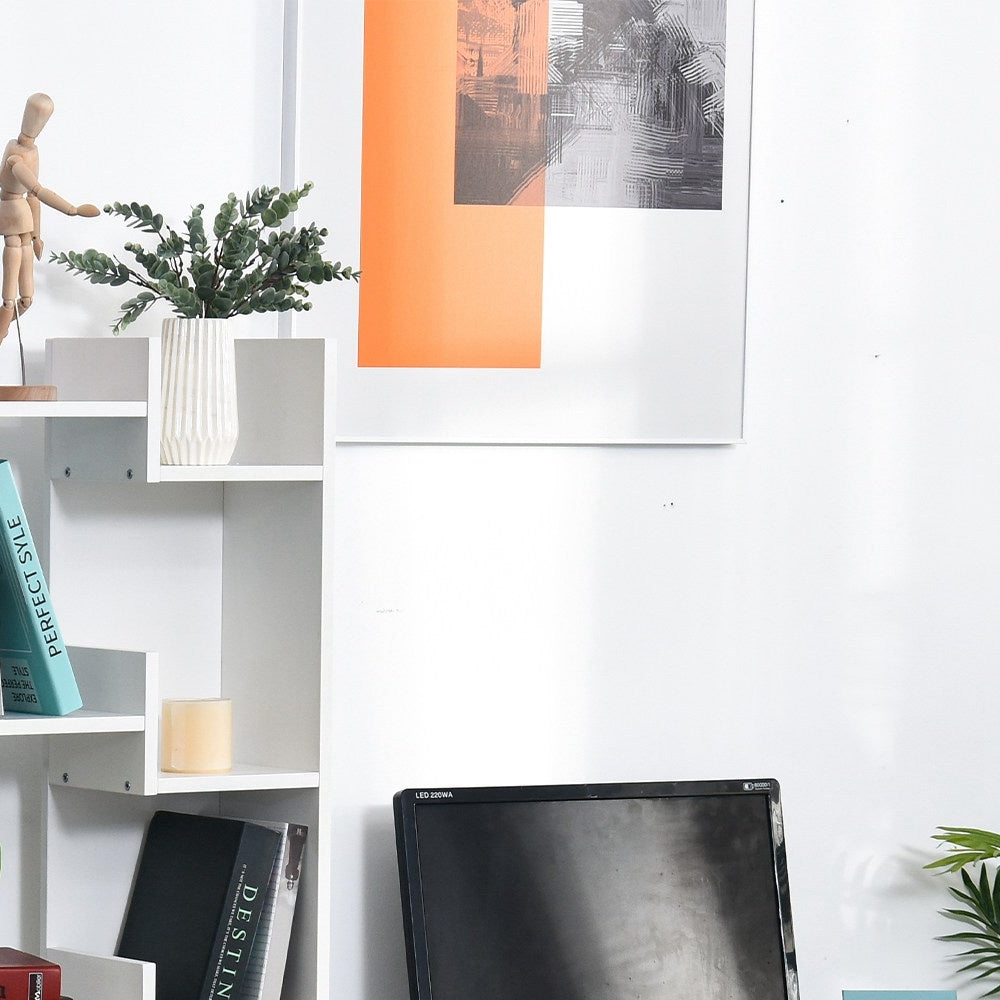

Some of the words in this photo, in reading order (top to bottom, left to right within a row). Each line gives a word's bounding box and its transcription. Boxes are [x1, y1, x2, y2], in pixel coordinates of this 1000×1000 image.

[8, 515, 34, 567] SYLE
[24, 570, 62, 658] PERFECT
[415, 791, 430, 799] LED
